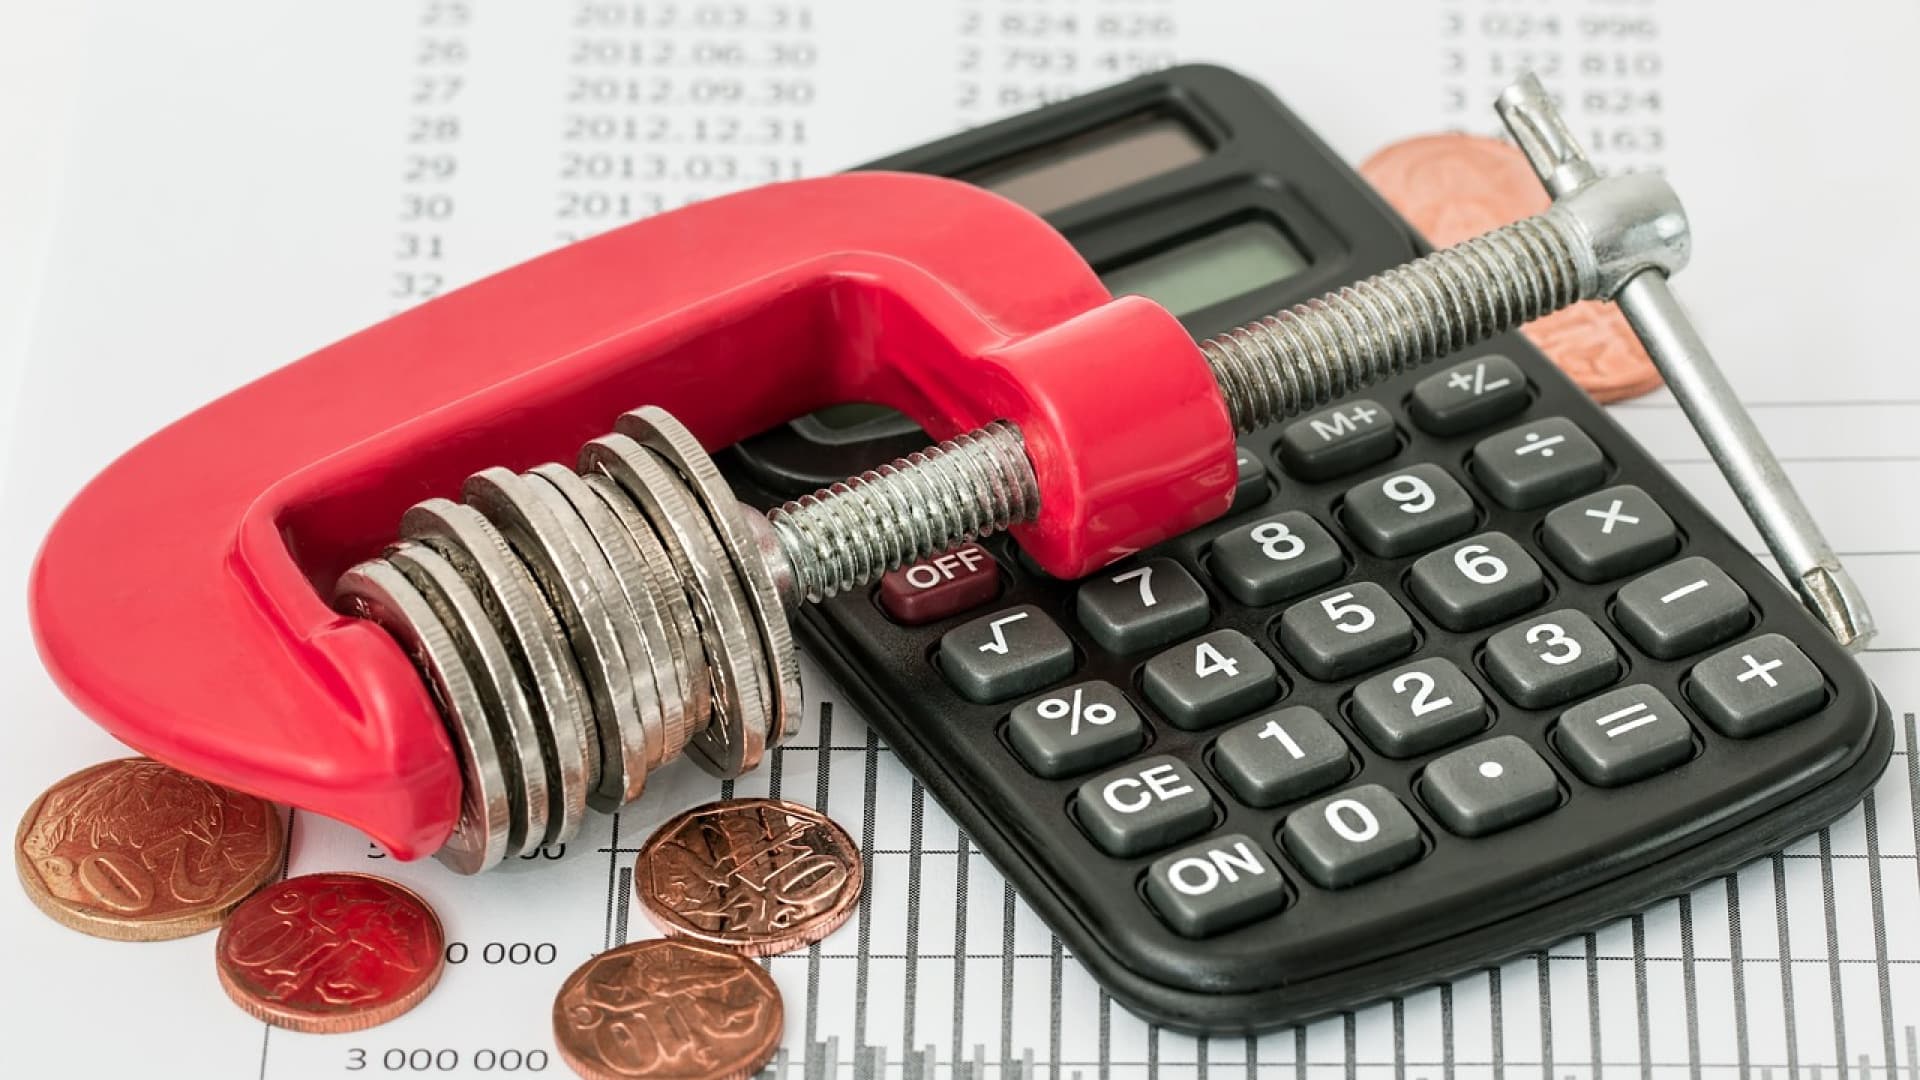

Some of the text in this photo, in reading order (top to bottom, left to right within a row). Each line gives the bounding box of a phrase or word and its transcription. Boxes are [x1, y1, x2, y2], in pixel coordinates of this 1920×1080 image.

[414, 77, 463, 102] 27
[568, 78, 815, 103] 2012.09.30
[409, 116, 460, 142] 28
[564, 117, 806, 143] 2012.12.31
[404, 155, 457, 181] 29
[400, 195, 454, 221] 30
[395, 234, 443, 260] 31
[391, 273, 443, 297] 32
[1309, 404, 1379, 441] M+
[1382, 474, 1437, 514] 9
[1250, 522, 1306, 561] 8
[905, 547, 984, 589] OFF
[1454, 544, 1509, 585] 6
[1112, 566, 1157, 607] 7
[1319, 591, 1376, 634] 5
[1194, 642, 1240, 678] 4
[1525, 623, 1582, 666] 3
[1036, 689, 1118, 736] %
[1391, 671, 1454, 718] 2
[1256, 720, 1306, 760] 1
[1102, 764, 1194, 814] CE
[1324, 798, 1380, 843] 0
[1167, 842, 1266, 896] ON
[482, 942, 558, 965] 000
[346, 1048, 549, 1072] 3 000 000
